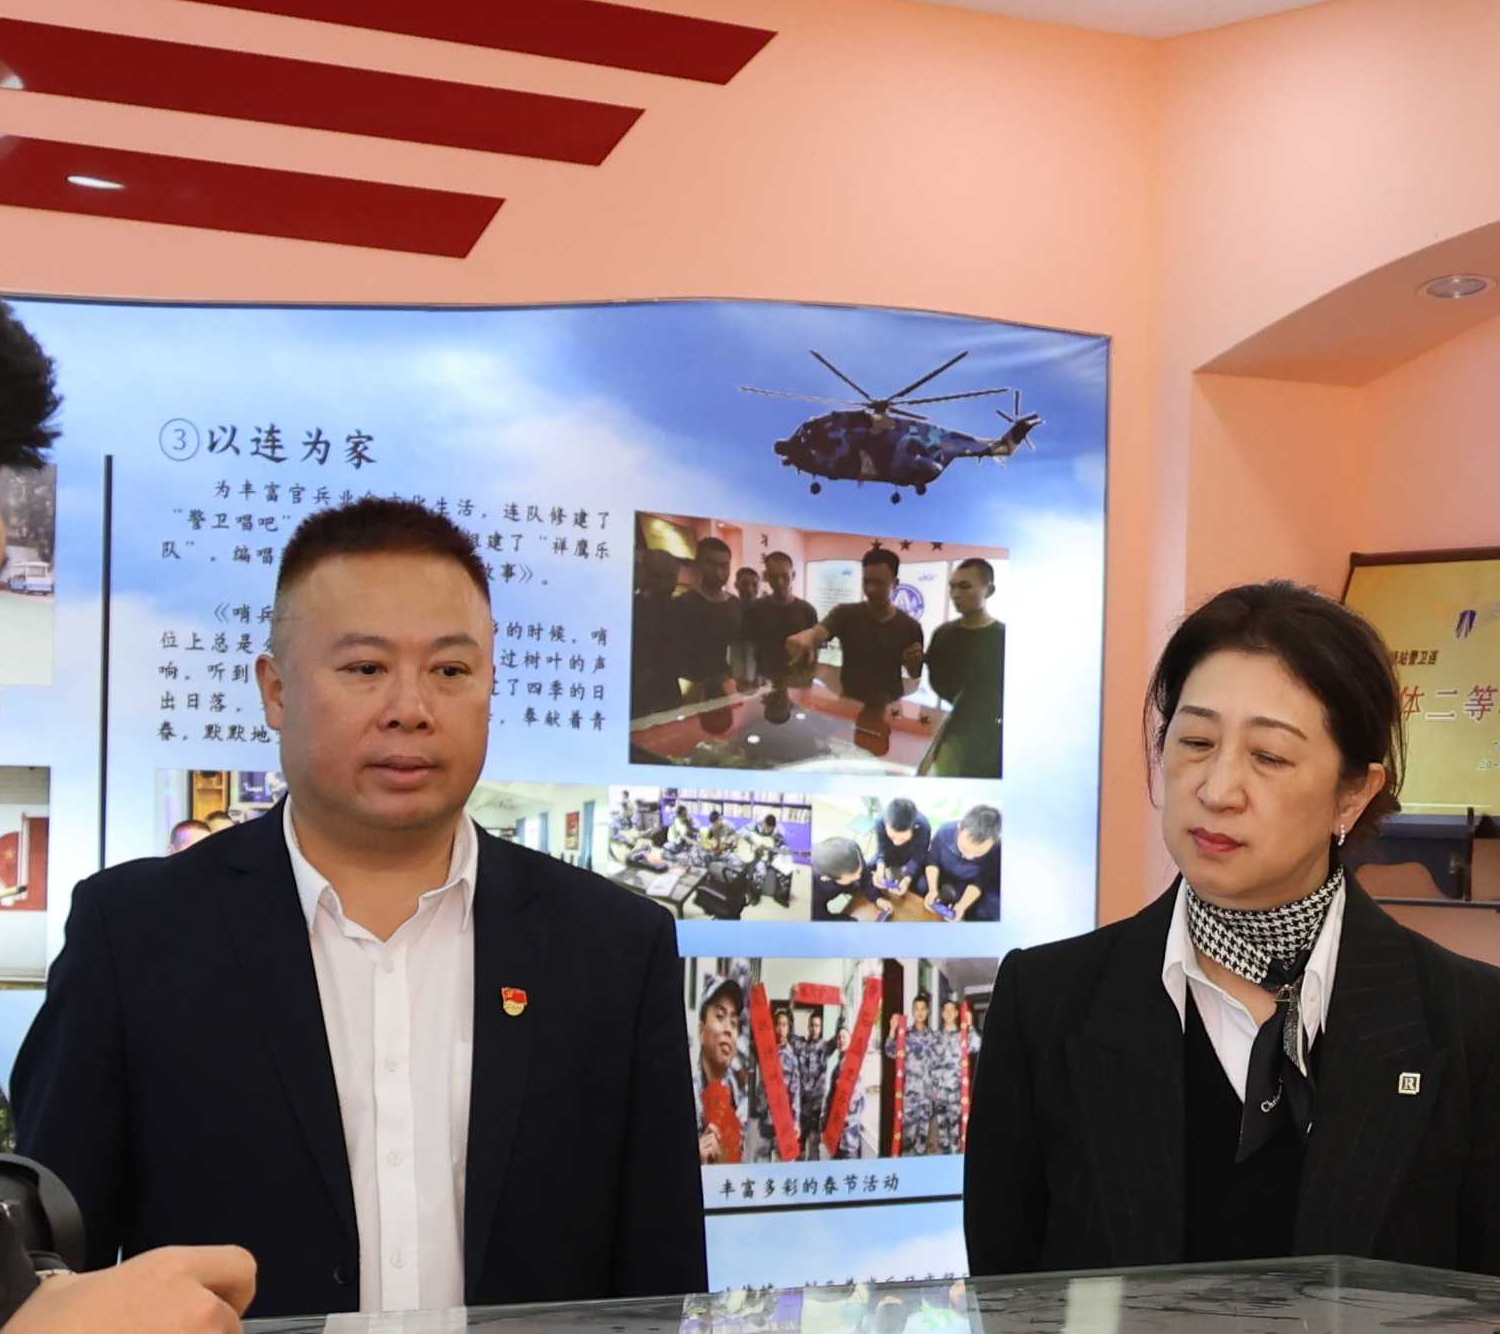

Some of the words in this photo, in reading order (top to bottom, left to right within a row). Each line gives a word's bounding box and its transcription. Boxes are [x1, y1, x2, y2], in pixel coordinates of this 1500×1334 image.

[719, 1173, 900, 1200] 丰富多彩的春节活动
